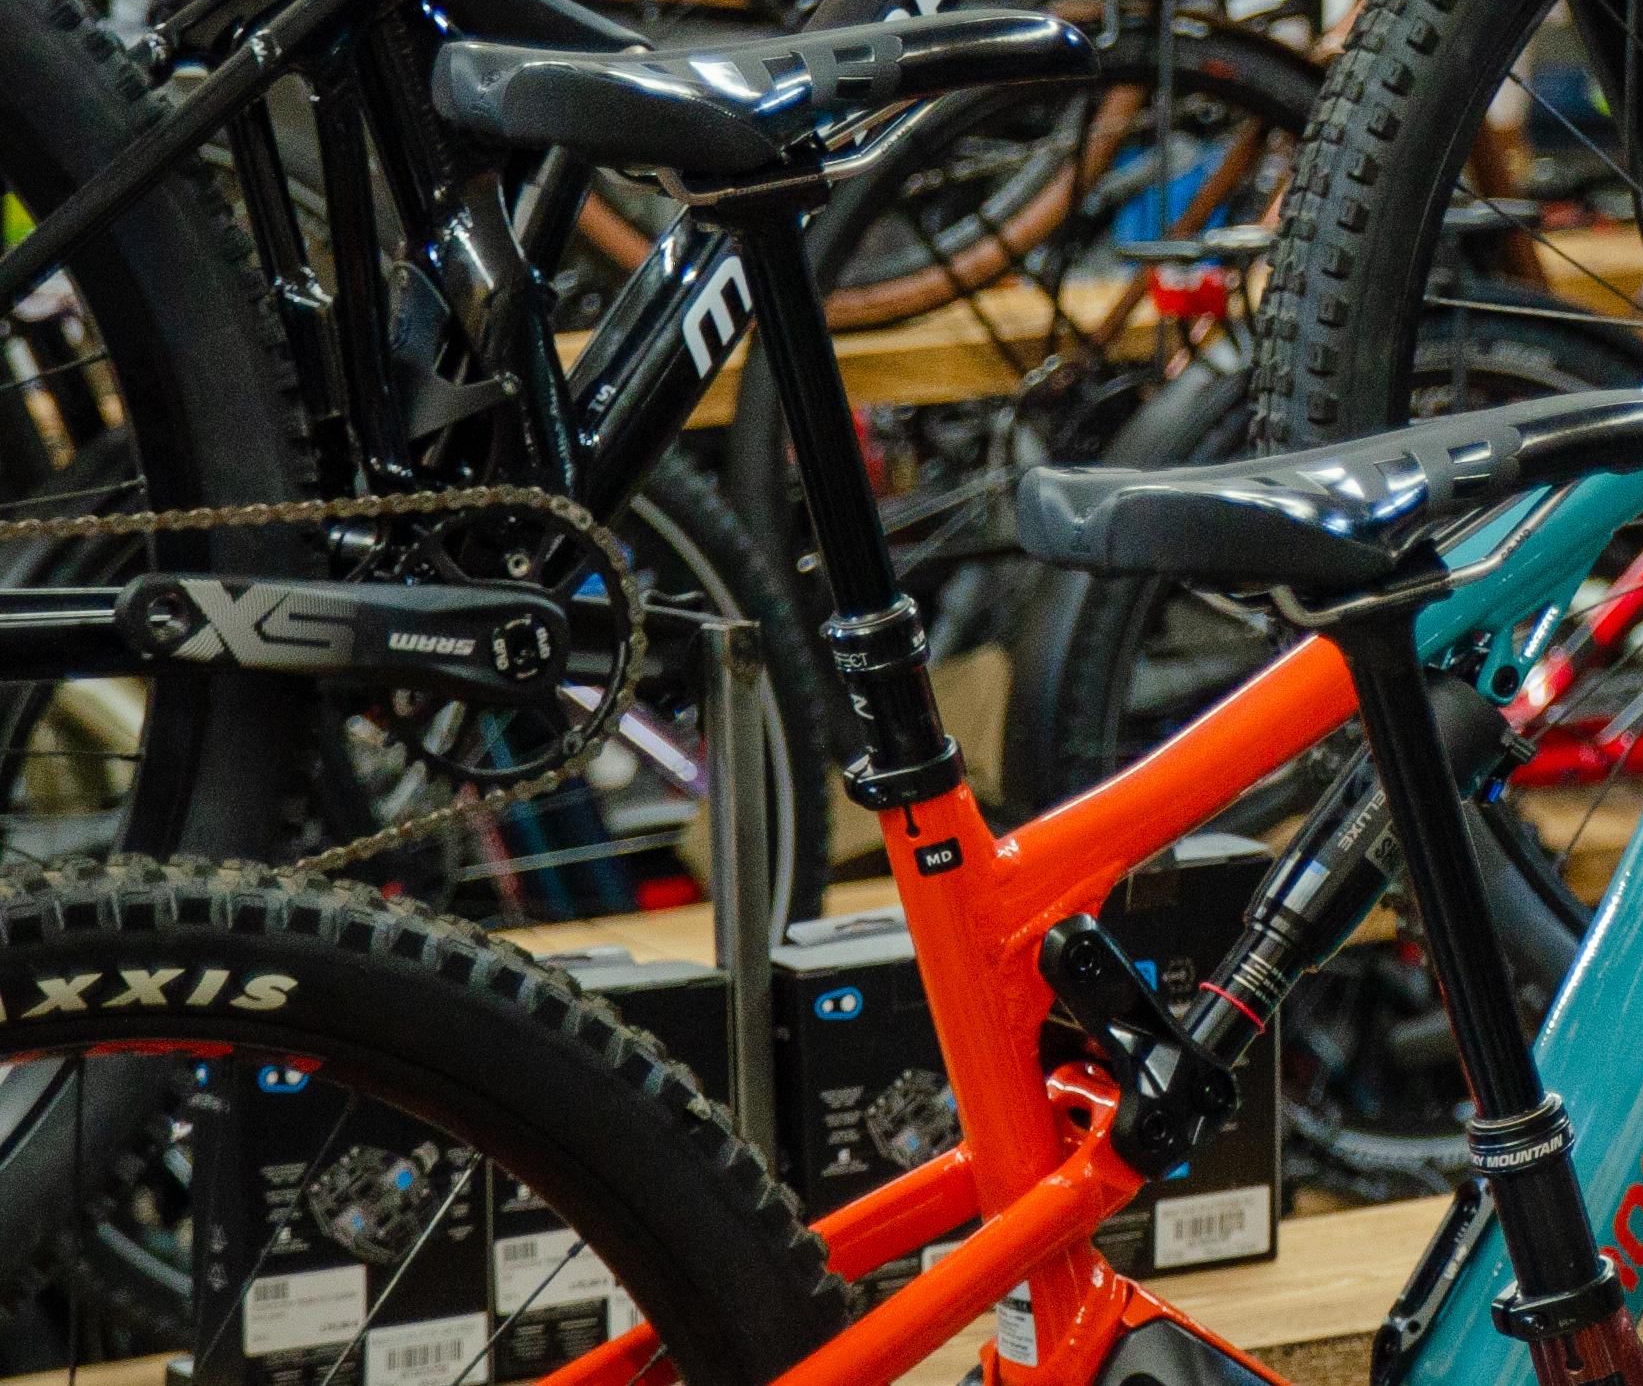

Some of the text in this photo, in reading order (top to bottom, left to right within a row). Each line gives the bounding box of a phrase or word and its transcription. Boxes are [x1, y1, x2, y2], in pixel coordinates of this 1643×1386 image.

[389, 631, 477, 656] SRAM
[926, 849, 953, 867] MD
[1487, 1133, 1563, 1168] MOUNTAIN
